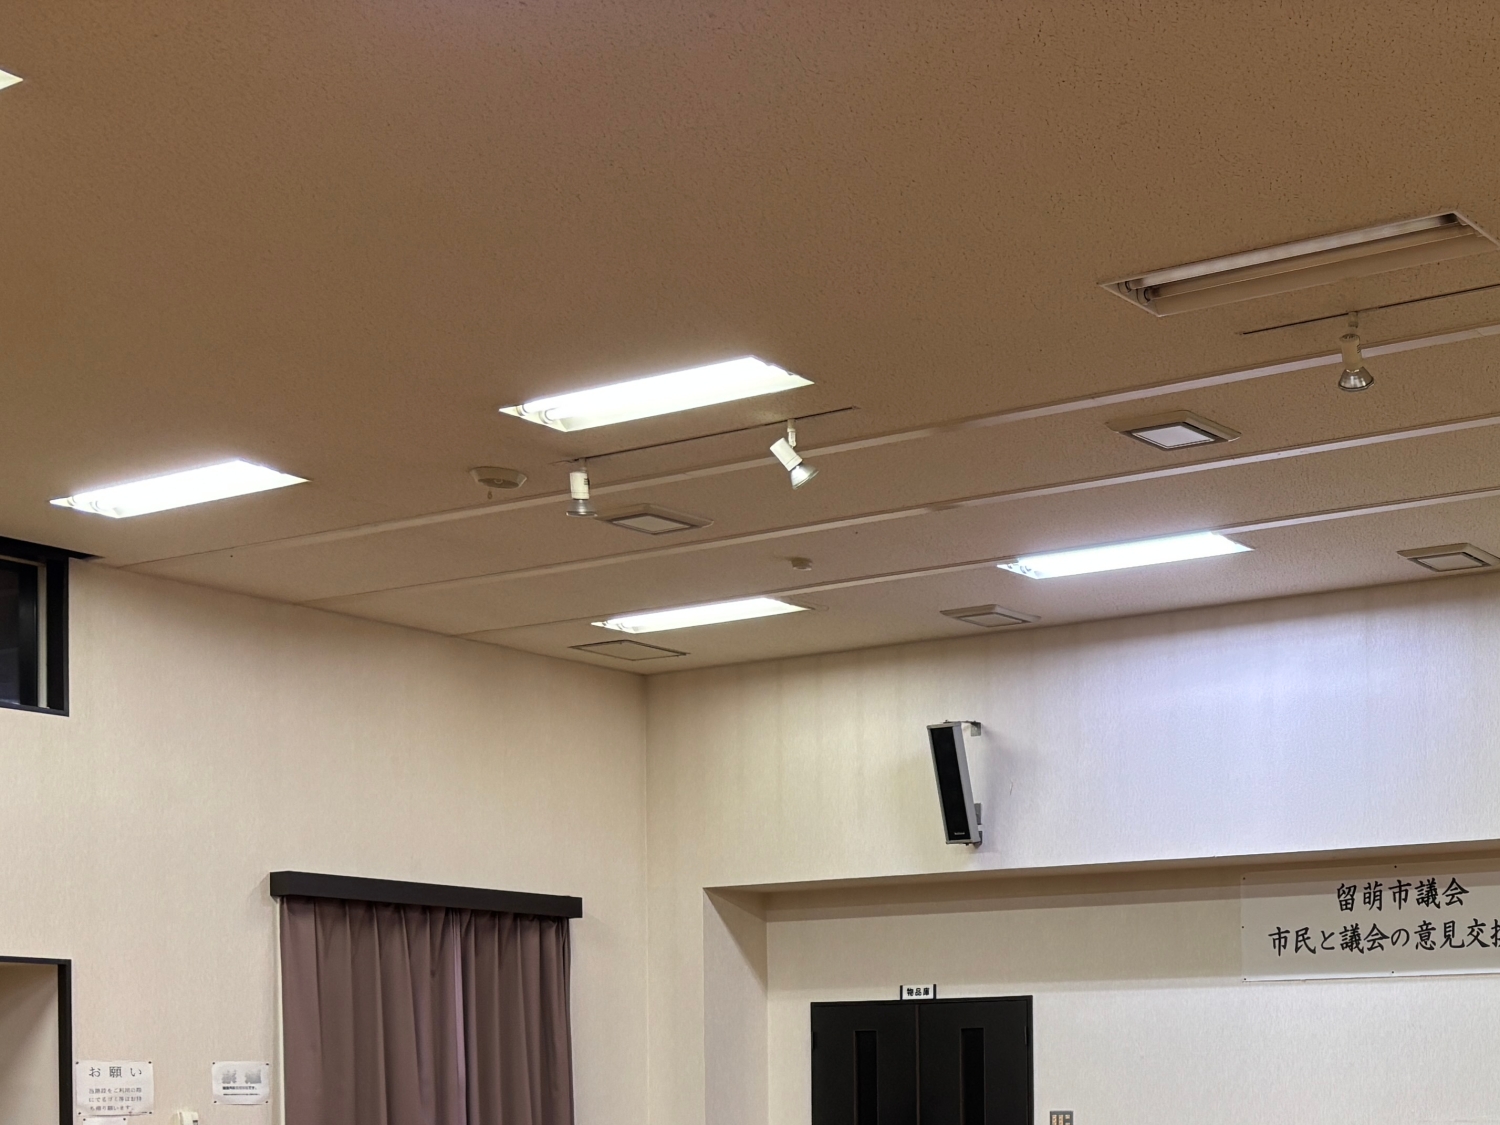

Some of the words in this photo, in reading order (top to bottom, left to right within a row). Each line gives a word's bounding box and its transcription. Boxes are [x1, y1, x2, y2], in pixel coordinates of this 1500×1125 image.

[1336, 877, 1469, 912] 留萌市議会
[906, 987, 931, 997] 物品庫
[89, 1066, 142, 1078] お願い
